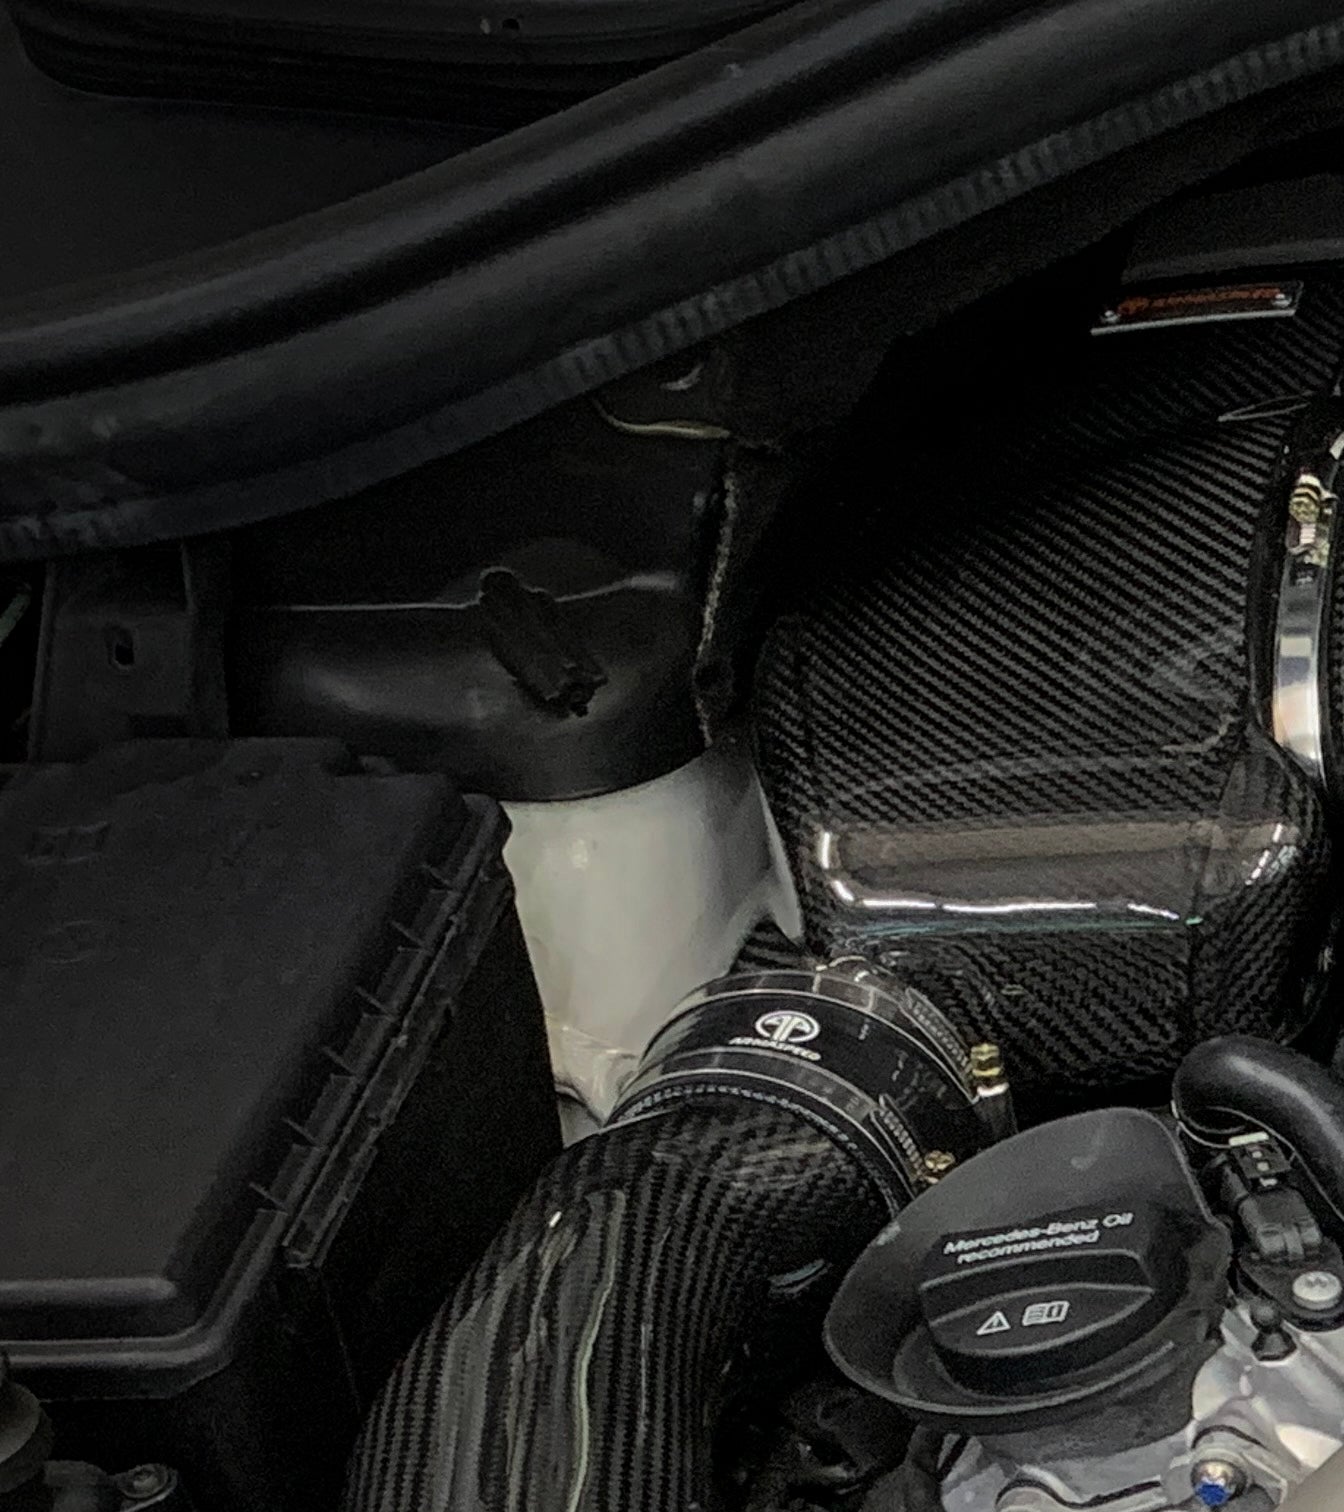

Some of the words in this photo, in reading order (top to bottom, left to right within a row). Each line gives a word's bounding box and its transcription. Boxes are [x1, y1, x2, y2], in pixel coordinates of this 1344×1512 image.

[944, 1219, 1098, 1254] Mercedes-Benz
[1102, 1212, 1134, 1228] Oil
[957, 1231, 1100, 1264] recommended
